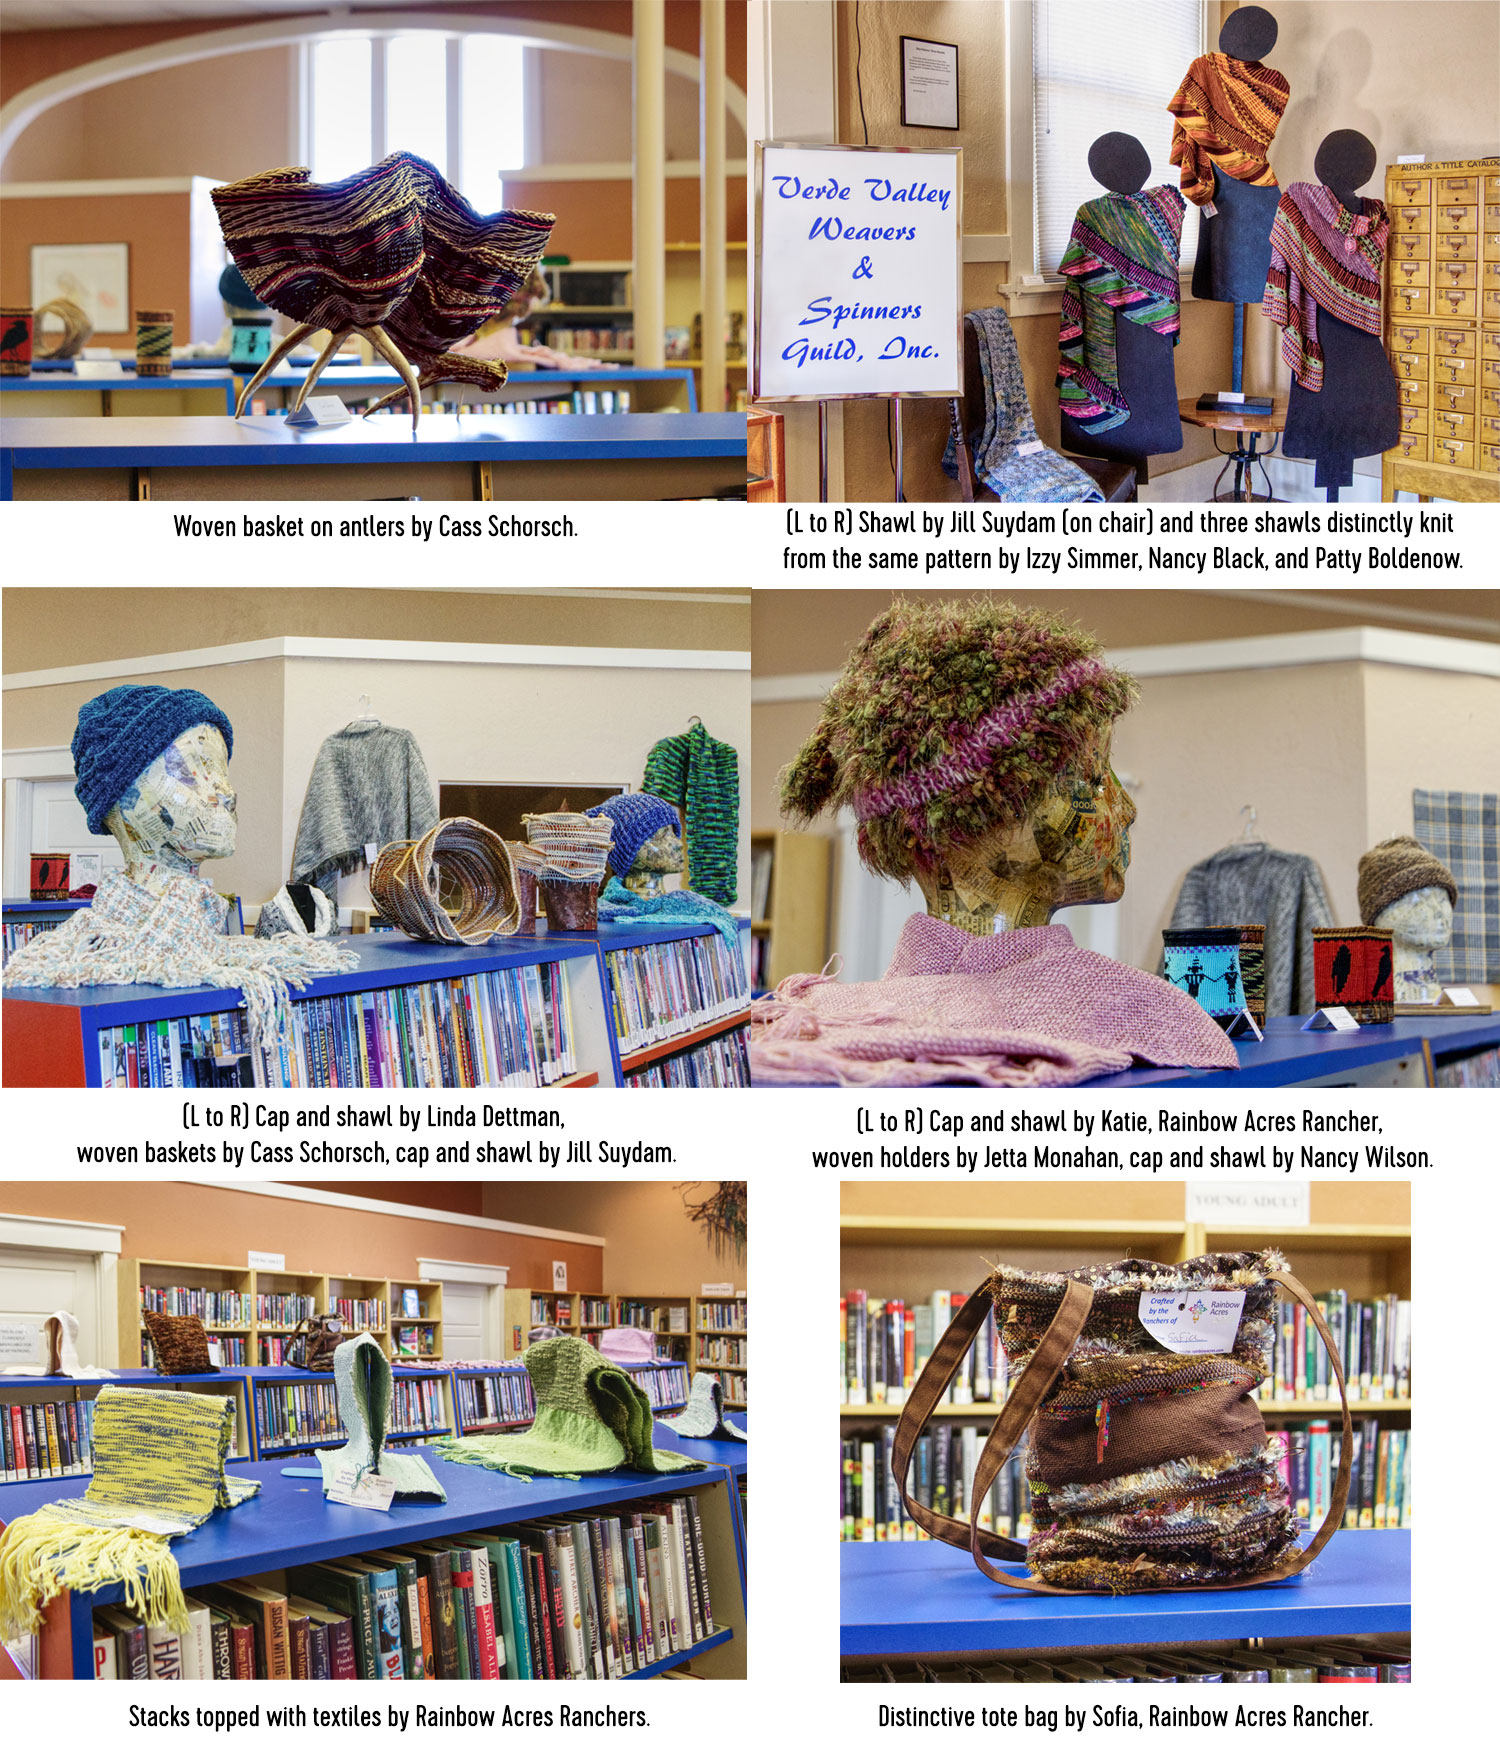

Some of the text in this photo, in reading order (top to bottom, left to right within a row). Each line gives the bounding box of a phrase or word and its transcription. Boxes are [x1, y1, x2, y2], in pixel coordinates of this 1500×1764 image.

[1401, 163, 1432, 171] AUTHOR
[1441, 161, 1464, 169] TITLE
[772, 175, 951, 211] Verde Valley
[808, 216, 916, 241] Weavers
[852, 255, 873, 280] &
[798, 296, 922, 330] Spinners
[781, 335, 939, 369] Guild, Inc.
[231, 1021, 242, 1052] MUSE
[1252, 1193, 1300, 1208] ADULT
[1148, 1307, 1156, 1315] by
[1150, 1297, 1176, 1305] Crafted
[1211, 1301, 1241, 1309] Rainbow
[595, 1527, 605, 1570] JEFFREY
[661, 1525, 669, 1560] ATKINS
[696, 1542, 707, 1572] GOOD
[478, 1557, 489, 1599] Zorro
[511, 1546, 524, 1592] Savannah
[567, 1547, 580, 1612] JEFFREY ARCHER
[684, 1533, 699, 1615] KATE ATKINSON
[409, 1588, 420, 1644] LOST LAKE
[468, 1592, 476, 1629] ALLENDE
[599, 1576, 610, 1625] ARCHER
[272, 1606, 286, 1676] SUSAN WITTIG
[363, 1608, 373, 1645] PRICE
[483, 1609, 494, 1650] ISABEL
